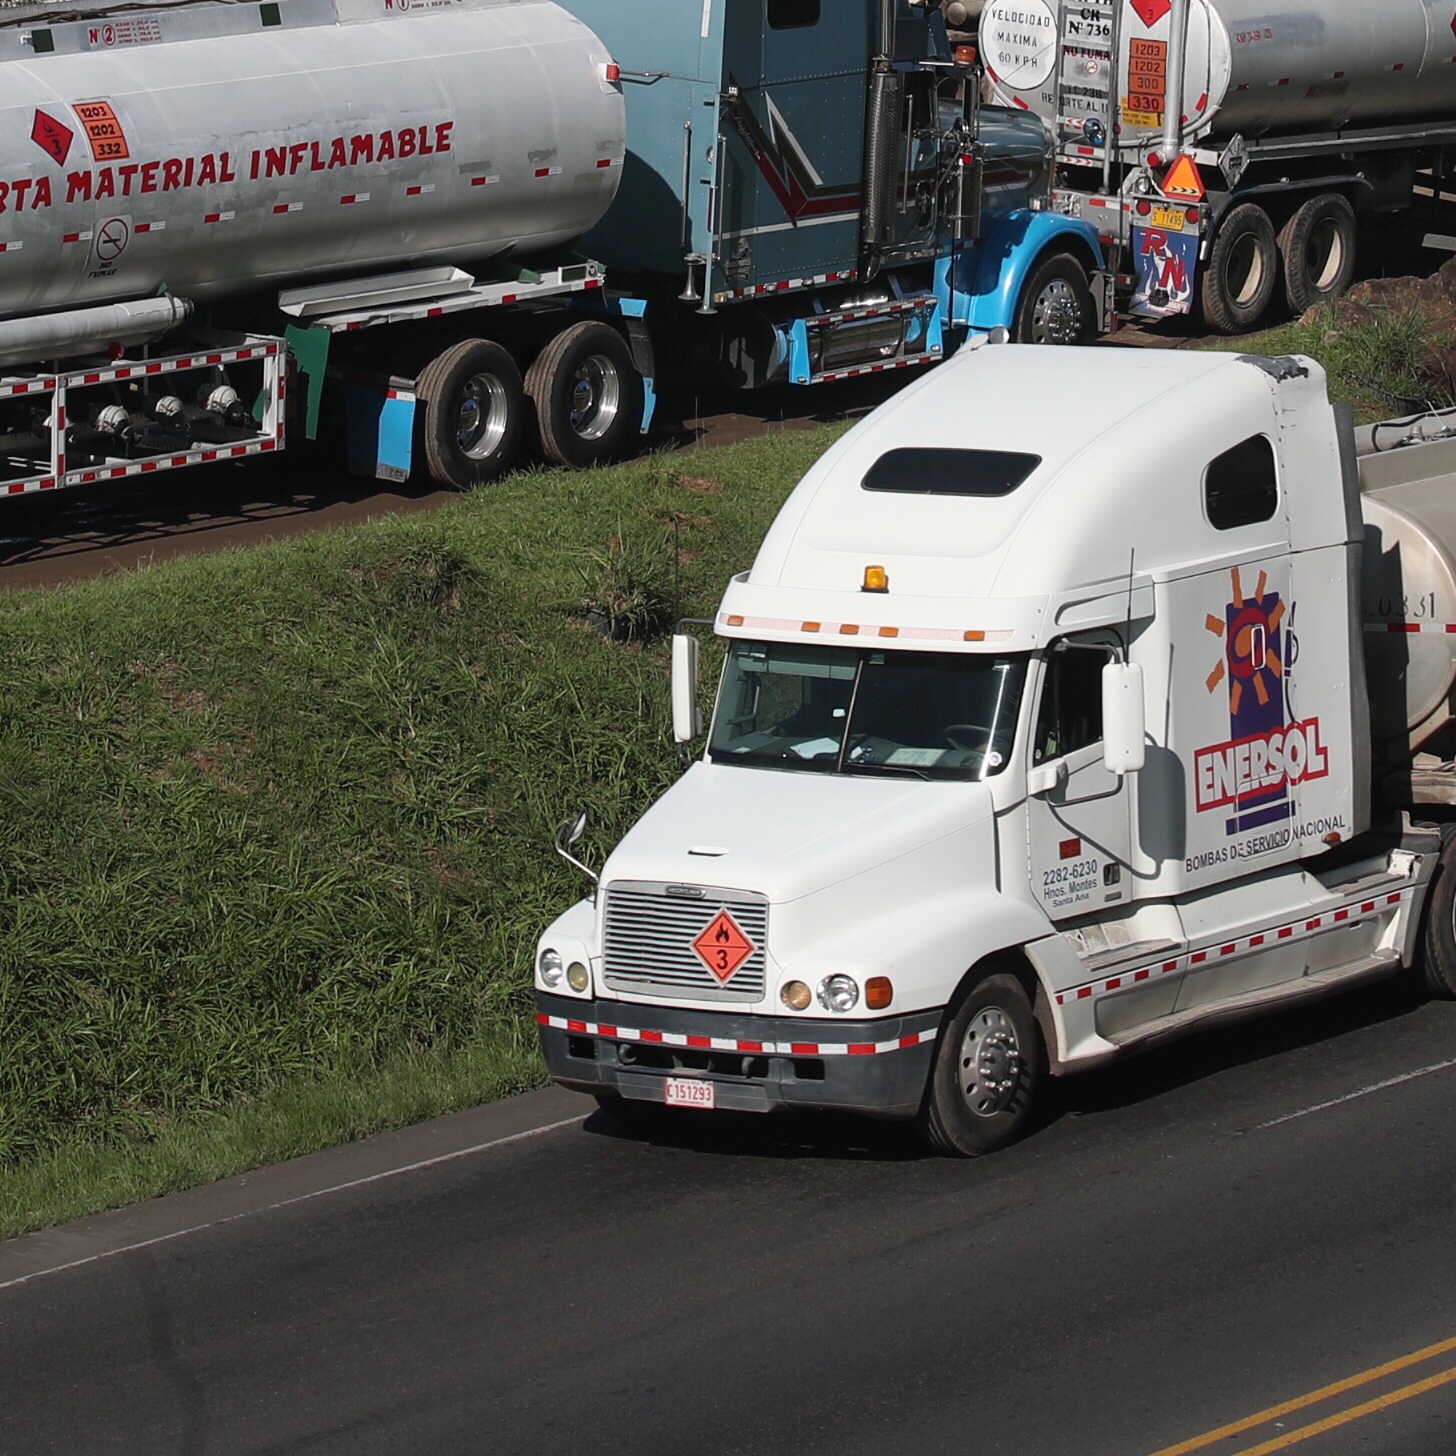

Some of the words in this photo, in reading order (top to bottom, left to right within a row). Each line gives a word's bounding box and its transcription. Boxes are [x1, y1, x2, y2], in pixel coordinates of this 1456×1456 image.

[991, 8, 1050, 28] VELOCIDAD
[1080, 8, 1101, 22] CR
[1146, 9, 1154, 20] 3
[105, 27, 113, 42] 2
[1087, 23, 1110, 36] 736
[997, 31, 1038, 48] MAXIMA
[998, 51, 1011, 64] 60
[1081, 47, 1112, 61] FUMA
[1135, 44, 1161, 57] 1203
[1134, 60, 1160, 73] 1202
[1137, 76, 1159, 90] 300
[1041, 92, 1084, 110] REORTE
[1085, 100, 1099, 113] AL
[1132, 95, 1160, 111] 330
[80, 106, 107, 118] 1203
[89, 123, 116, 137] 1202
[51, 139, 62, 156] 3
[98, 143, 122, 156] 332
[66, 151, 236, 204] MATERIAL
[249, 121, 455, 180] INFLAMABLE
[1152, 212, 1157, 222] S
[1161, 213, 1183, 226] 11495
[99, 261, 112, 269] NO
[1196, 722, 1327, 807] ENERSOL
[1185, 845, 1228, 873] BOMBAS
[1230, 842, 1244, 859] DE
[1245, 828, 1291, 855] SERVICIO
[1293, 814, 1346, 839] NACIONAL
[1042, 858, 1098, 887] 2282-6230
[1068, 878, 1098, 894] Montes
[1052, 896, 1074, 908] Santa
[1074, 892, 1090, 903] Ana
[715, 949, 729, 970] 3
[665, 1083, 712, 1101] C151293
